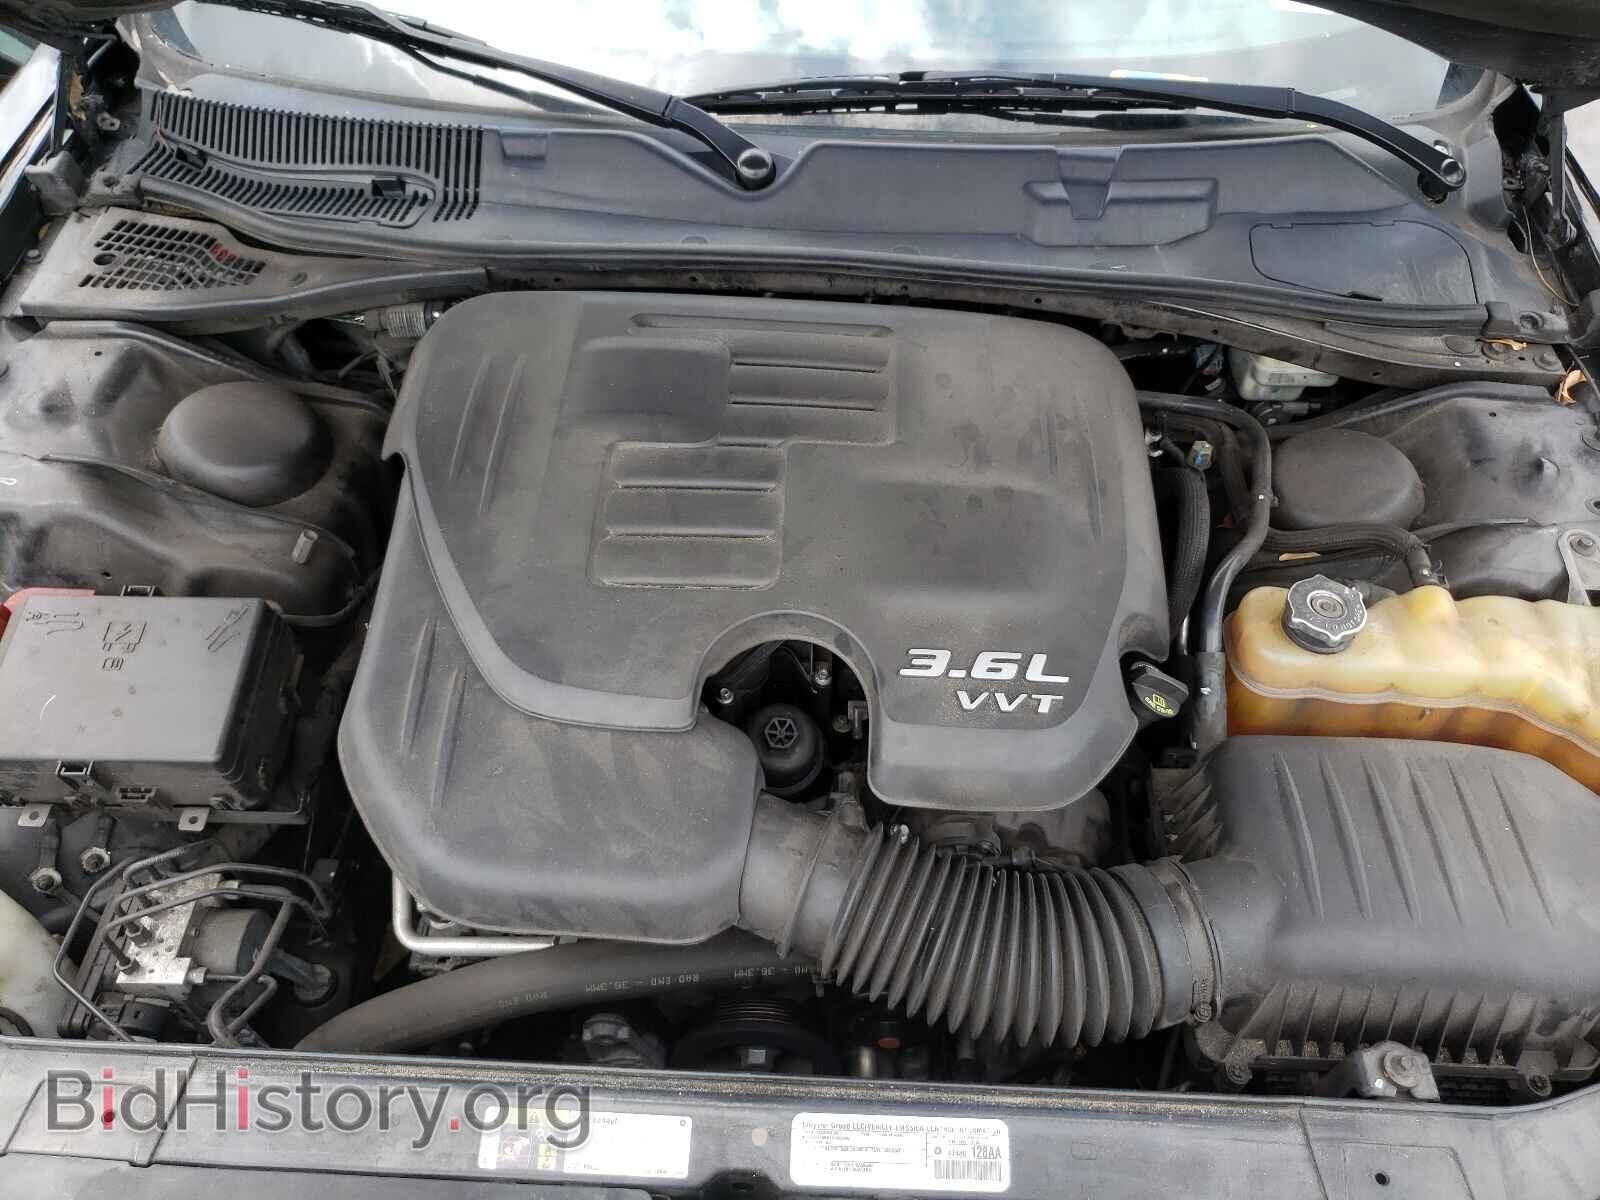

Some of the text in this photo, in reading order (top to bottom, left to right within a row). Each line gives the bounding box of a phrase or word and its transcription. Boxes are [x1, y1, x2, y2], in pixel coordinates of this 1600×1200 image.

[899, 648, 1070, 683] 3.6L
[956, 690, 1064, 713] VVT
[679, 972, 700, 984] RAD
